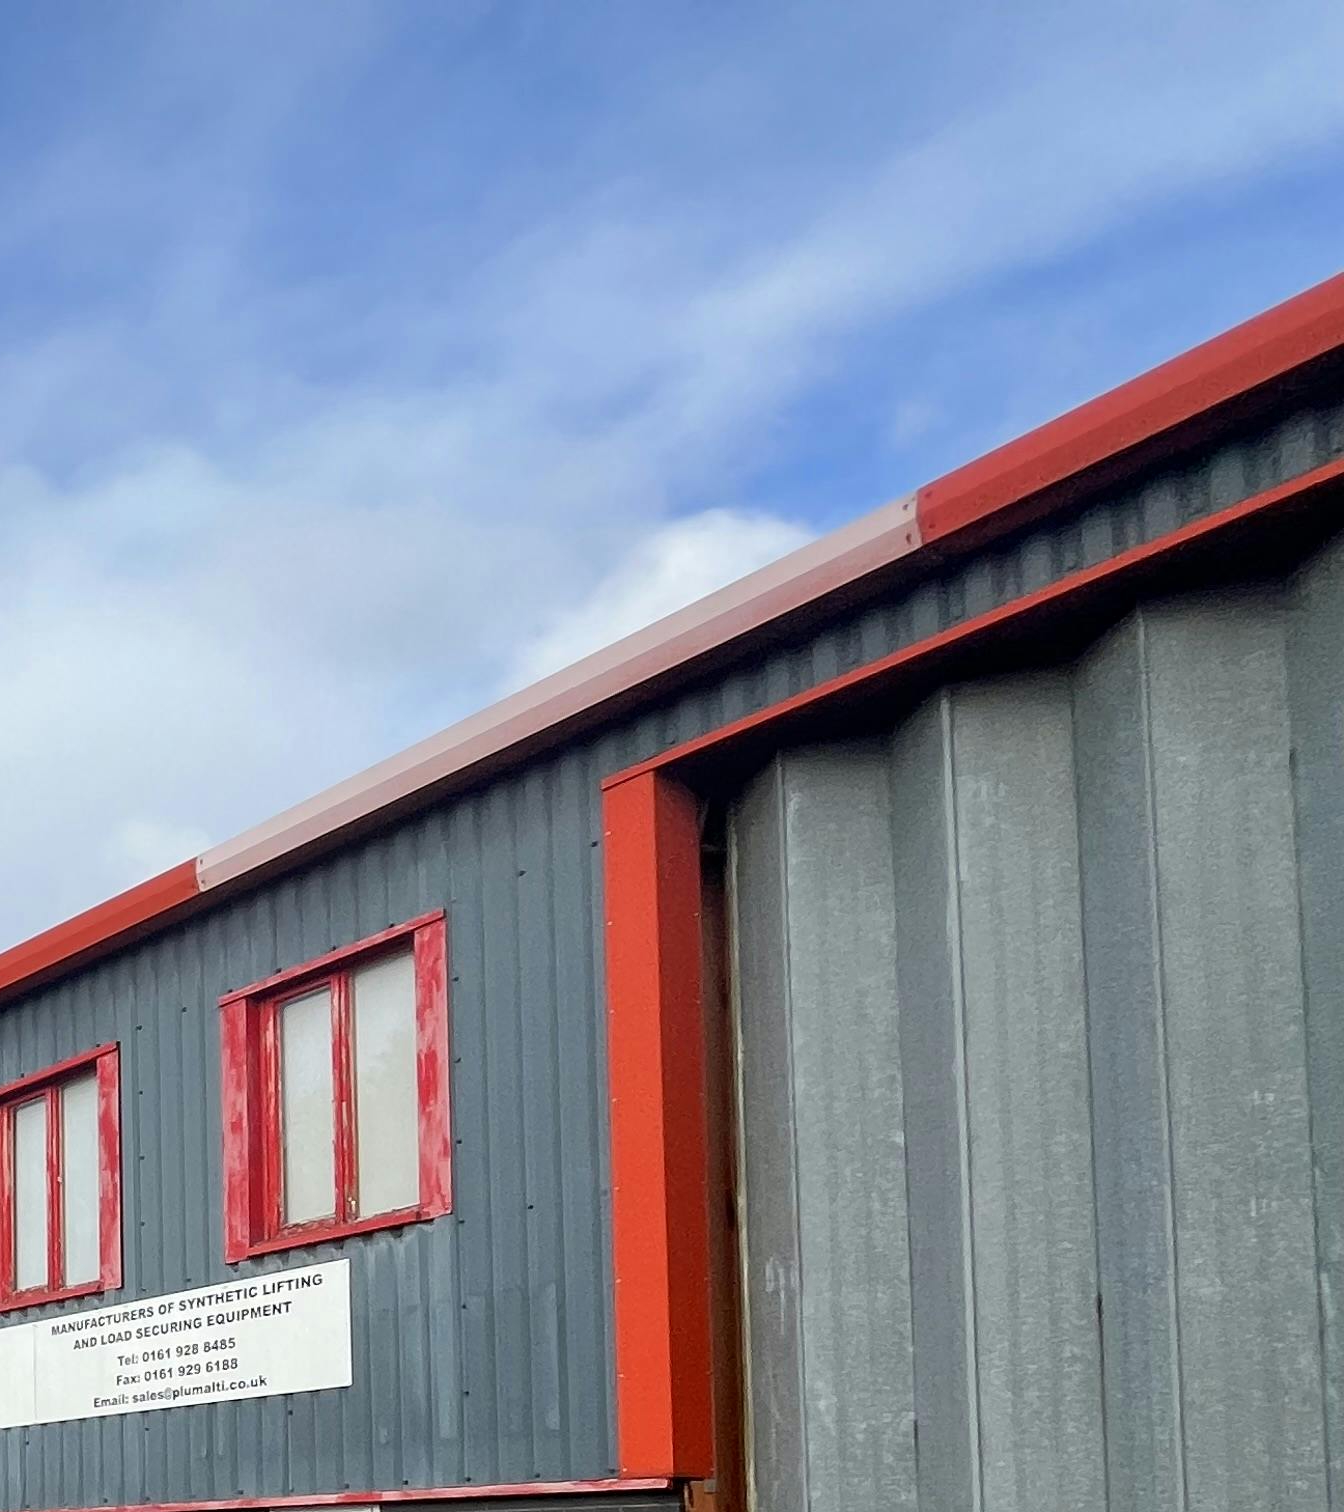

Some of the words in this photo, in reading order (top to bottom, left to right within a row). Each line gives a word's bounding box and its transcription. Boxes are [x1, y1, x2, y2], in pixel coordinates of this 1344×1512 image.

[51, 1306, 154, 1336] MANUFACTURERS
[158, 1302, 174, 1315] OF
[178, 1286, 258, 1311] SYNTHETIC
[262, 1273, 323, 1295] LIFTING
[73, 1336, 98, 1350] AND
[100, 1330, 132, 1345] LOAD
[135, 1317, 202, 1340] SECURING
[206, 1301, 292, 1327] EQUIPMENT
[117, 1355, 139, 1367] Tel:
[142, 1348, 171, 1362] 0161
[176, 1343, 199, 1358] 928
[203, 1337, 236, 1353] 8485
[116, 1374, 141, 1386] Fax:
[144, 1366, 173, 1382] 0161
[178, 1363, 201, 1377] 929
[205, 1358, 238, 1373] 6188
[93, 1393, 129, 1408] Email:
[132, 1374, 268, 1404] sales@plumalti.co.uk
